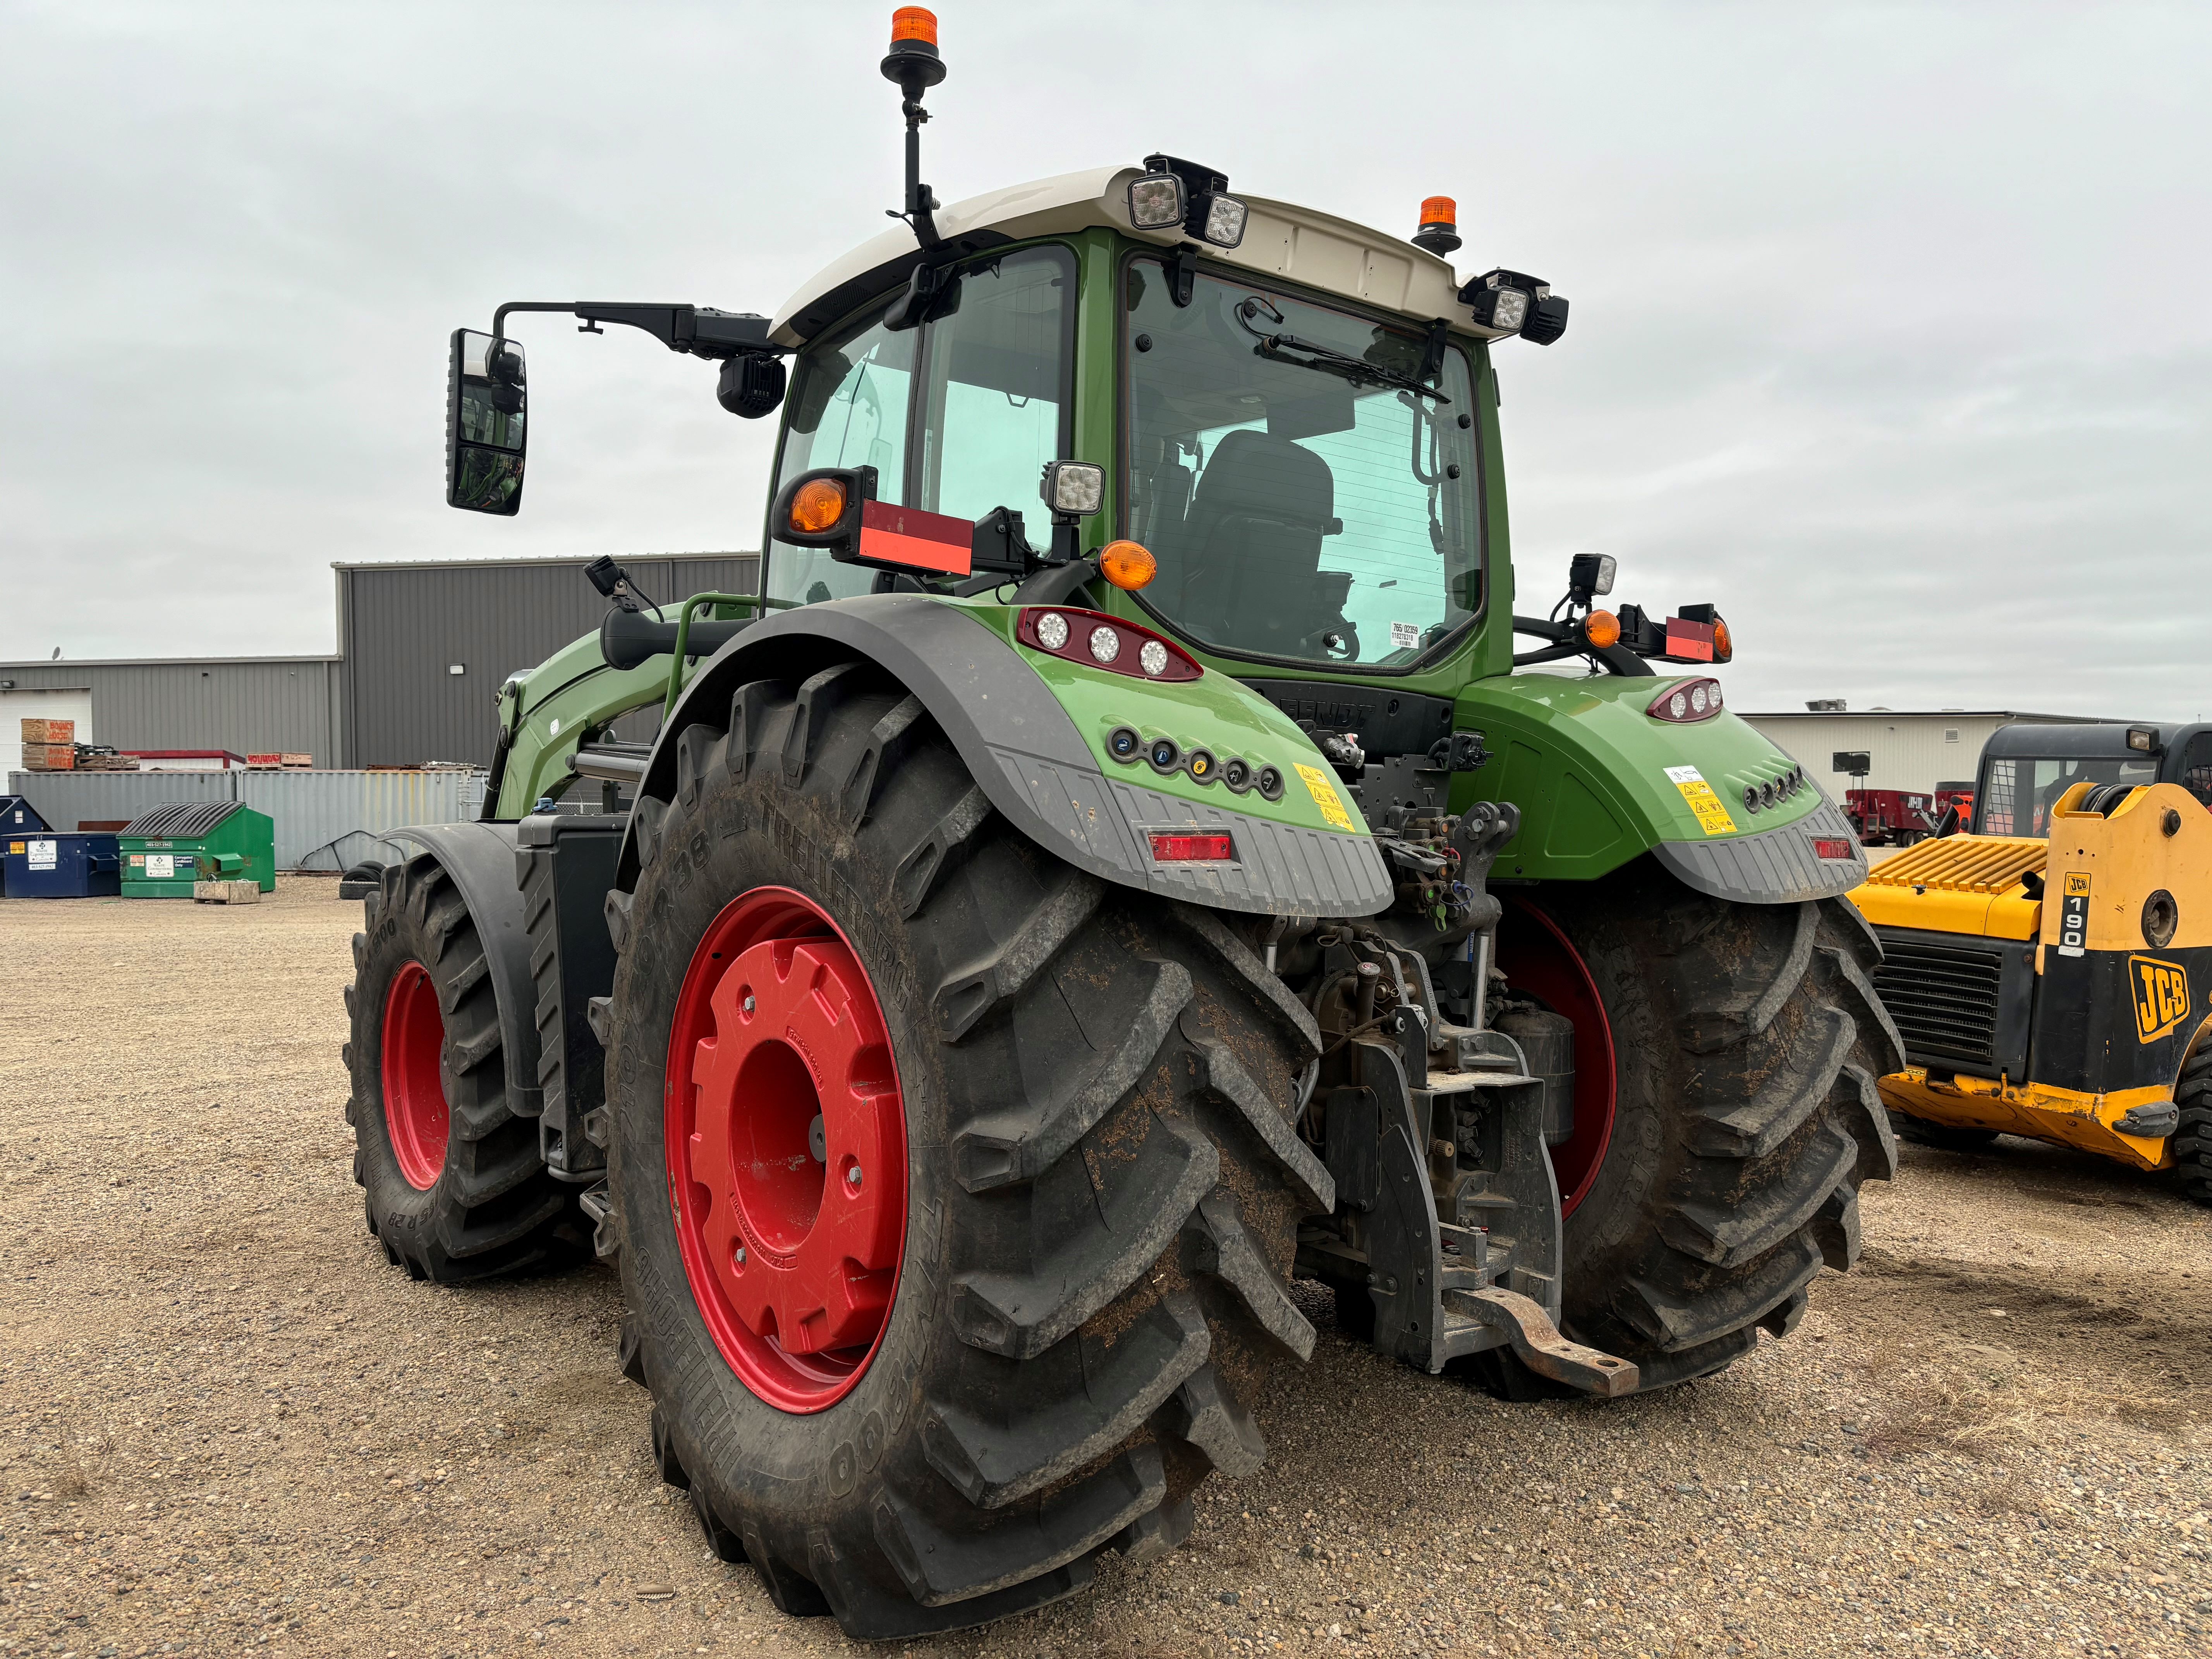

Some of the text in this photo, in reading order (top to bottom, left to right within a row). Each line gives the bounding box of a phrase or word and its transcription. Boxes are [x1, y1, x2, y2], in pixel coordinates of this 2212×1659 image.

[1391, 632, 1413, 641] 118278318
[1280, 698, 1376, 729] FENDT
[760, 791, 912, 1012] TRELLEBORG
[2071, 878, 2087, 891] JCB
[2064, 897, 2082, 946] 190
[2140, 964, 2186, 1033] JCB
[632, 1247, 743, 1496] TRELLEBORG
